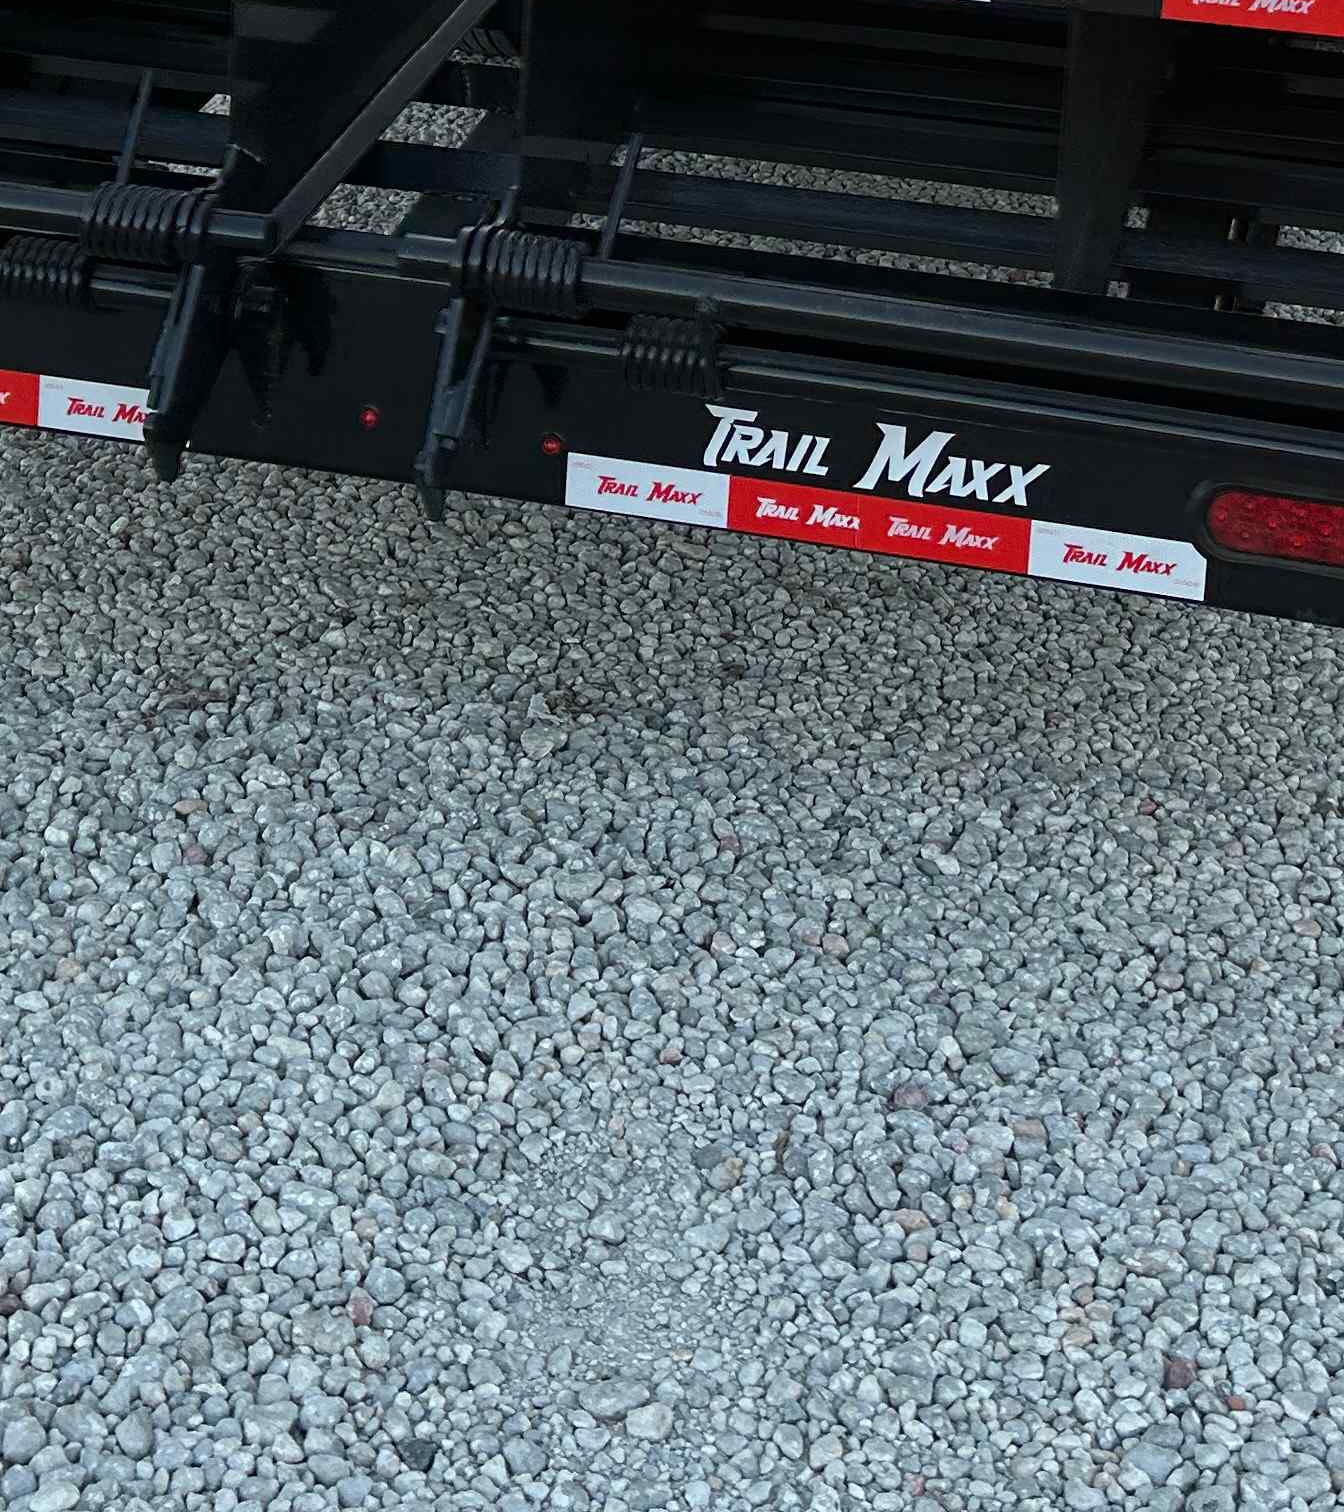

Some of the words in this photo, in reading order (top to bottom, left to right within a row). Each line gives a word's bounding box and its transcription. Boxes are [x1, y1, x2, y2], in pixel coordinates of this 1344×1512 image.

[67, 396, 105, 418] TRAIL
[703, 403, 832, 477] TRAIL
[852, 422, 1052, 507] MAXX
[596, 475, 640, 497] TRAIL
[646, 481, 702, 506] MAXX
[756, 496, 800, 521] TRAIL
[887, 515, 933, 540] TRAIL
[937, 523, 1000, 551] MAXX
[1062, 543, 1107, 567] TRAIL
[1115, 550, 1177, 577] MAXX
